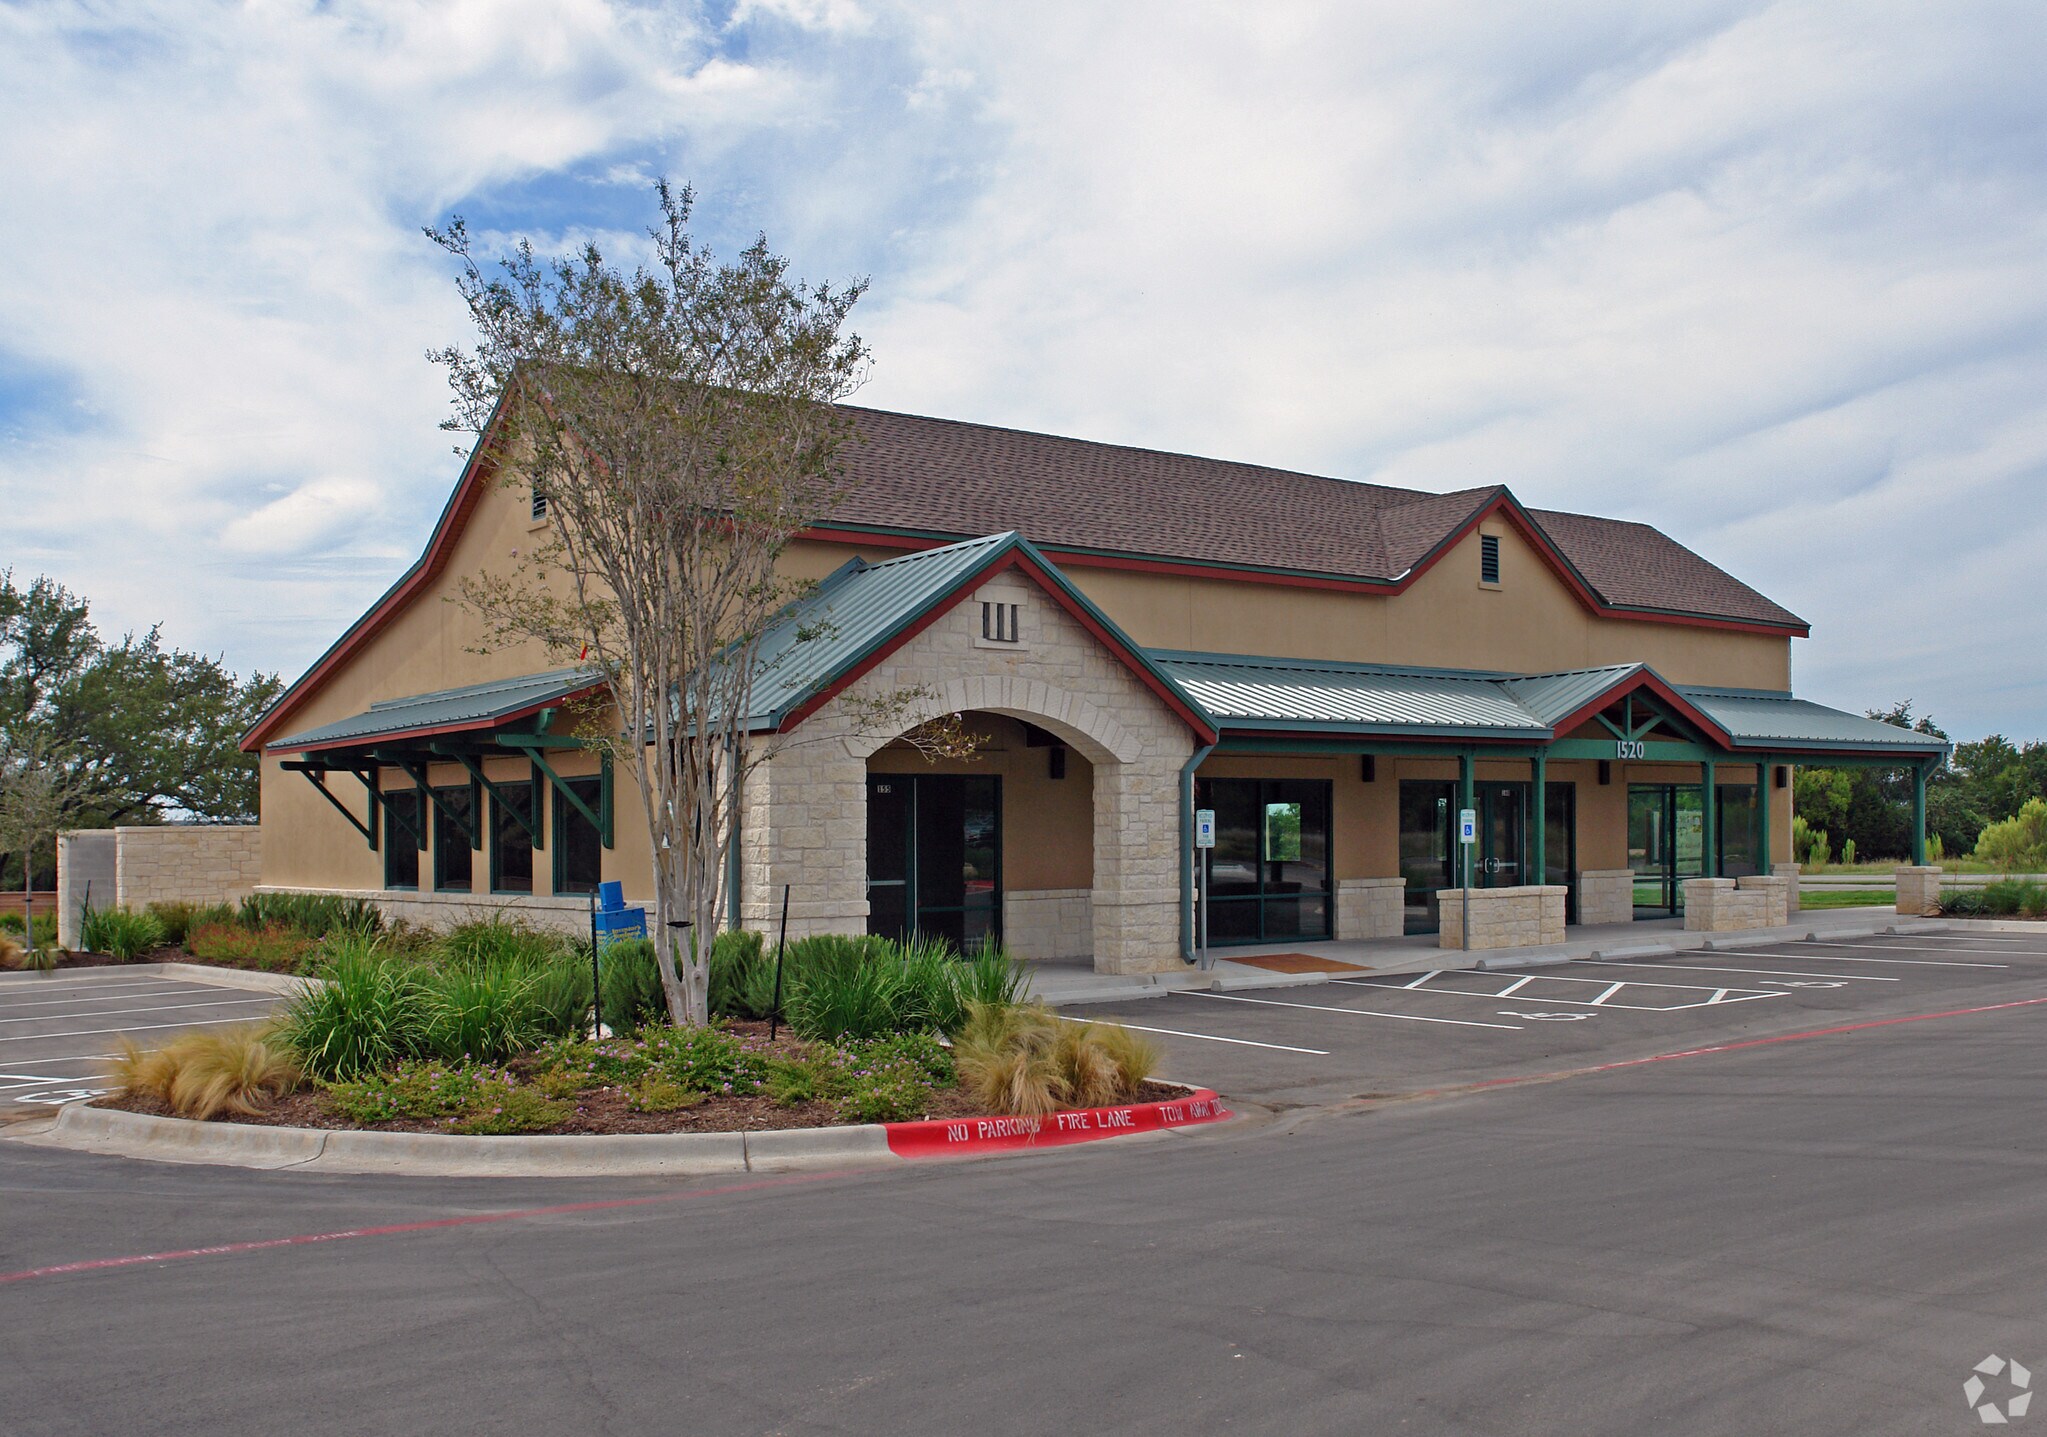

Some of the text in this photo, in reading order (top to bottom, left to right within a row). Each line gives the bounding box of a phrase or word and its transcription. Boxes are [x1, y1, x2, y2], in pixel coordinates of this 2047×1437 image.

[1617, 741, 1644, 759] 1520
[947, 1124, 969, 1142] NO
[1057, 1112, 1091, 1130] FIRE
[1096, 1109, 1135, 1128] LANE
[1159, 1106, 1184, 1122] TOW
[1210, 1098, 1227, 1116] ZO
